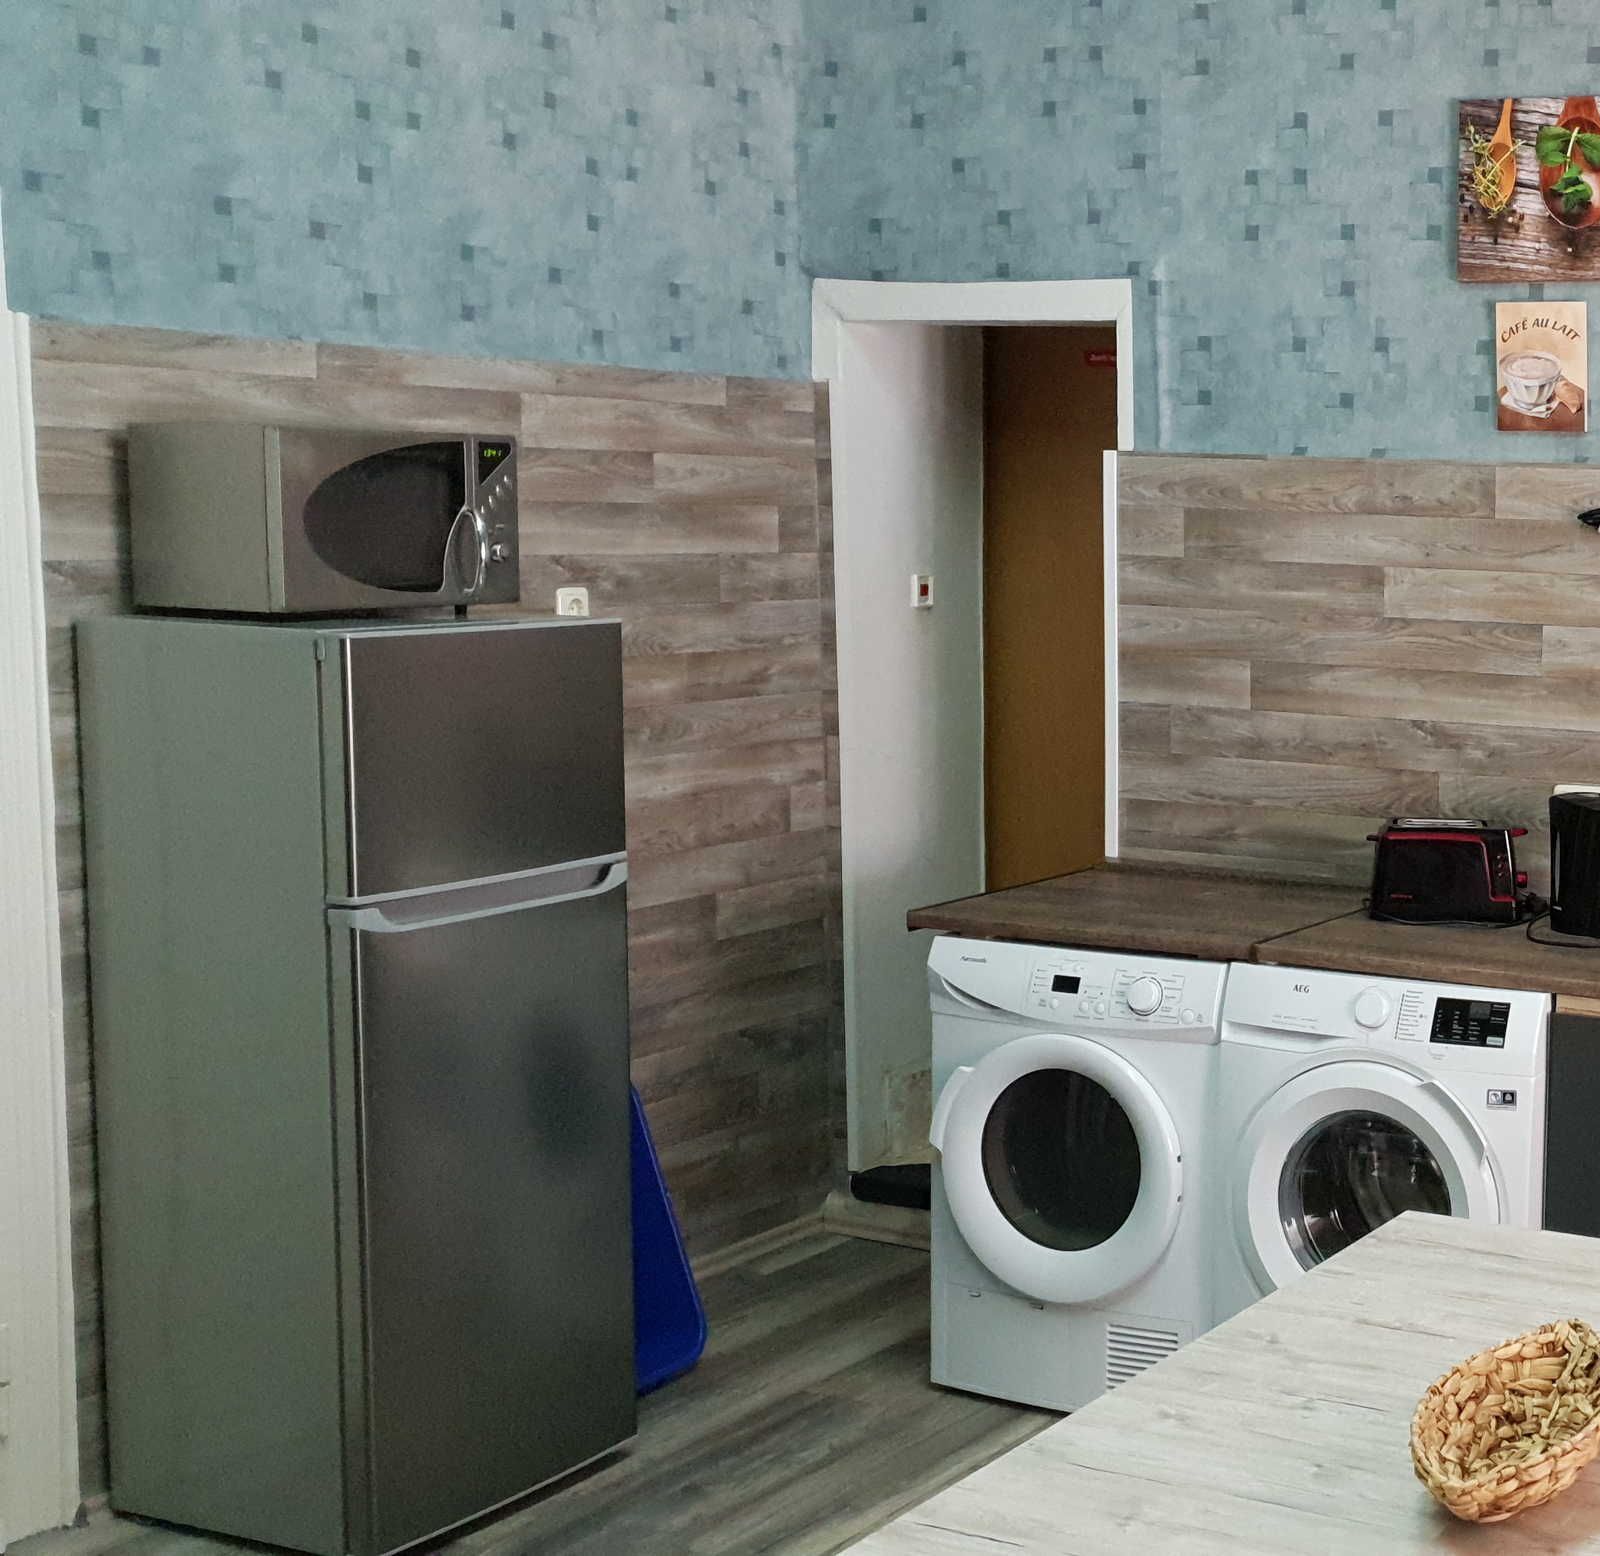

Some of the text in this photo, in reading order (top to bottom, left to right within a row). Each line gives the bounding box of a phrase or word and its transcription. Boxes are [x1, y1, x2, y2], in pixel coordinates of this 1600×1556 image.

[1531, 318, 1550, 329] AU
[1551, 320, 1580, 341] LAIT
[1292, 984, 1311, 994] AEG
